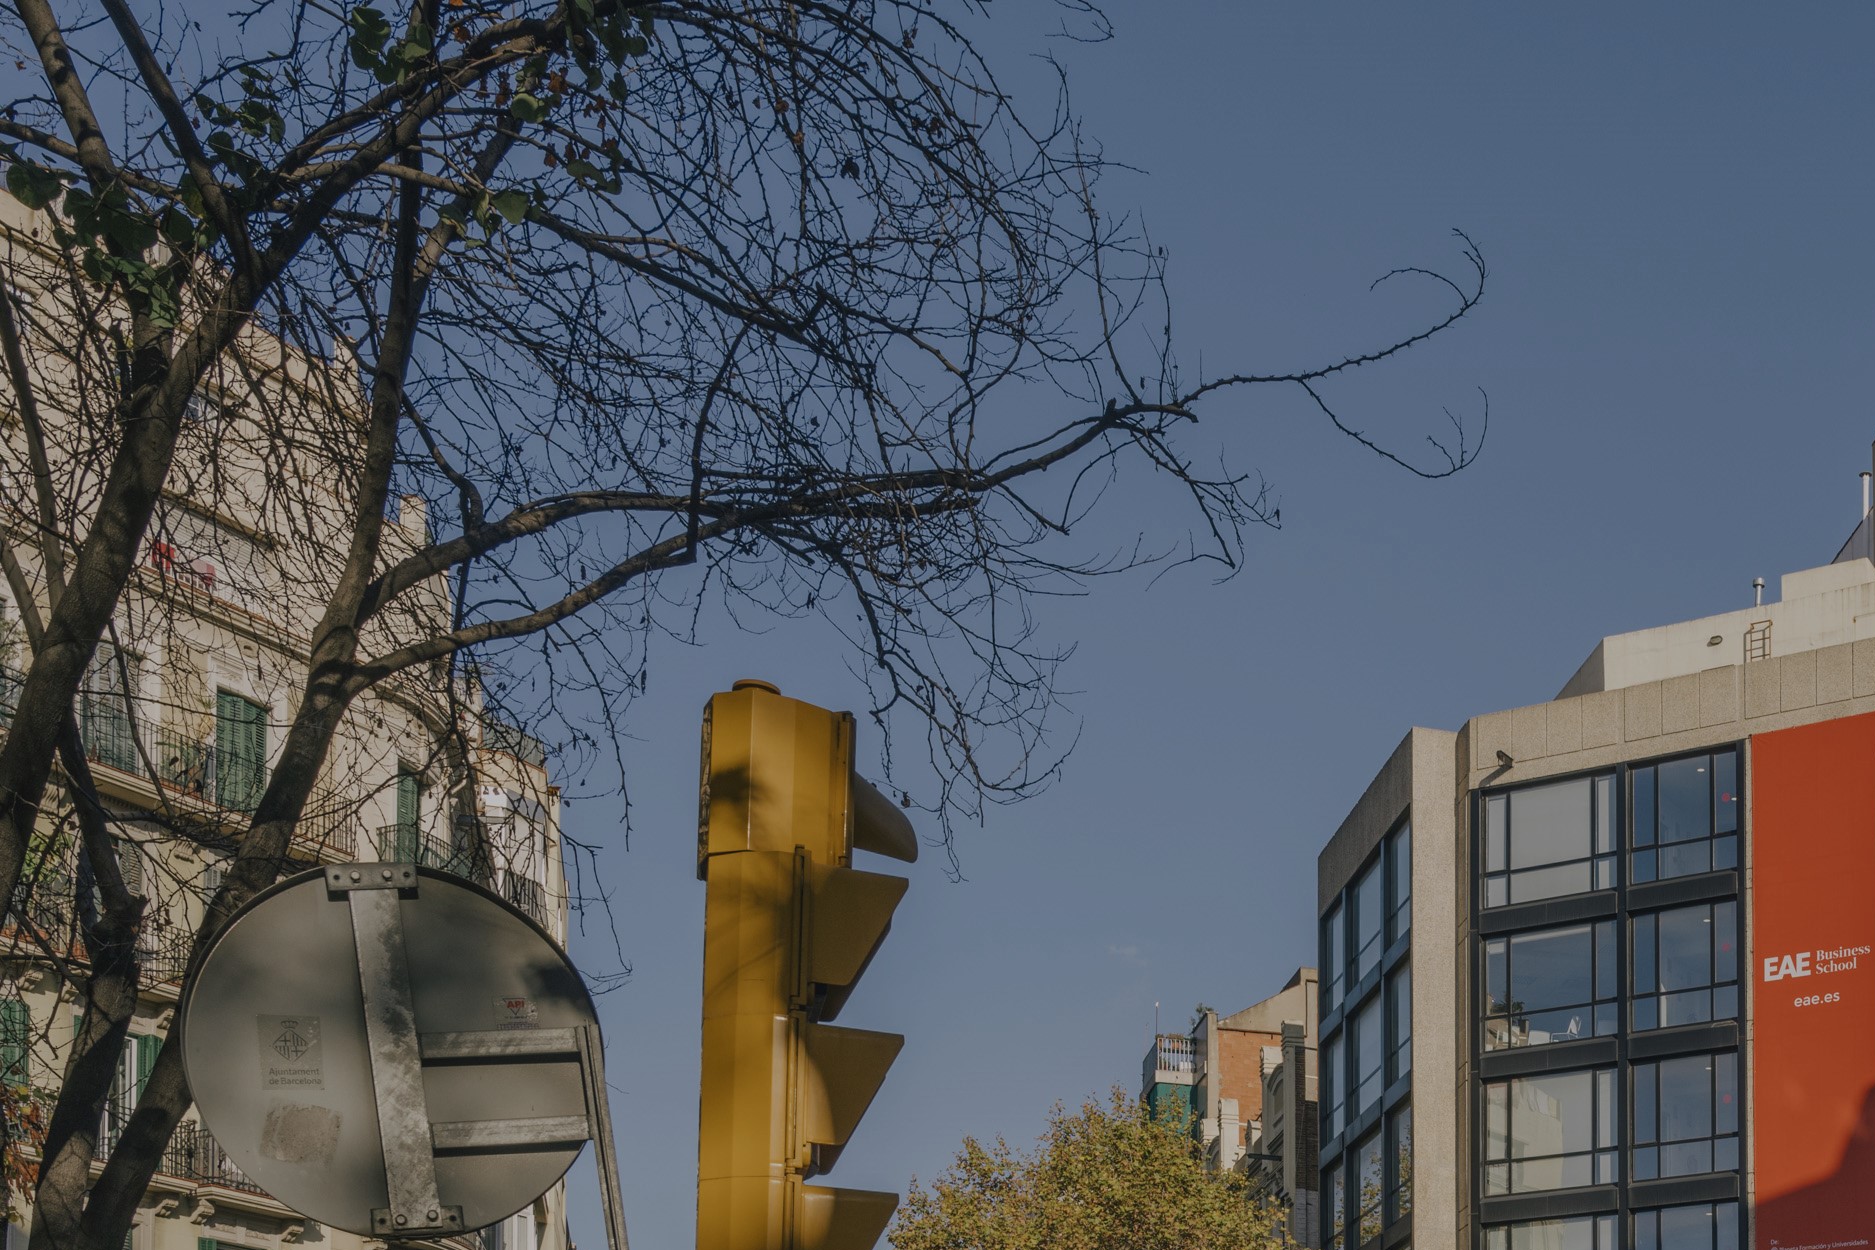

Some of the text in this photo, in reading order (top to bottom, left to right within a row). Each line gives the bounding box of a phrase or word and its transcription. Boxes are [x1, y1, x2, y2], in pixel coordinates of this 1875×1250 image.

[1816, 945, 1871, 961] Business
[1764, 952, 1811, 982] EAE
[1815, 957, 1857, 975] School
[1794, 992, 1841, 1007] eae.es
[269, 1068, 319, 1076] Ajuntament
[281, 1077, 322, 1085] Barcelona
[1832, 1239, 1869, 1248] Universidades
